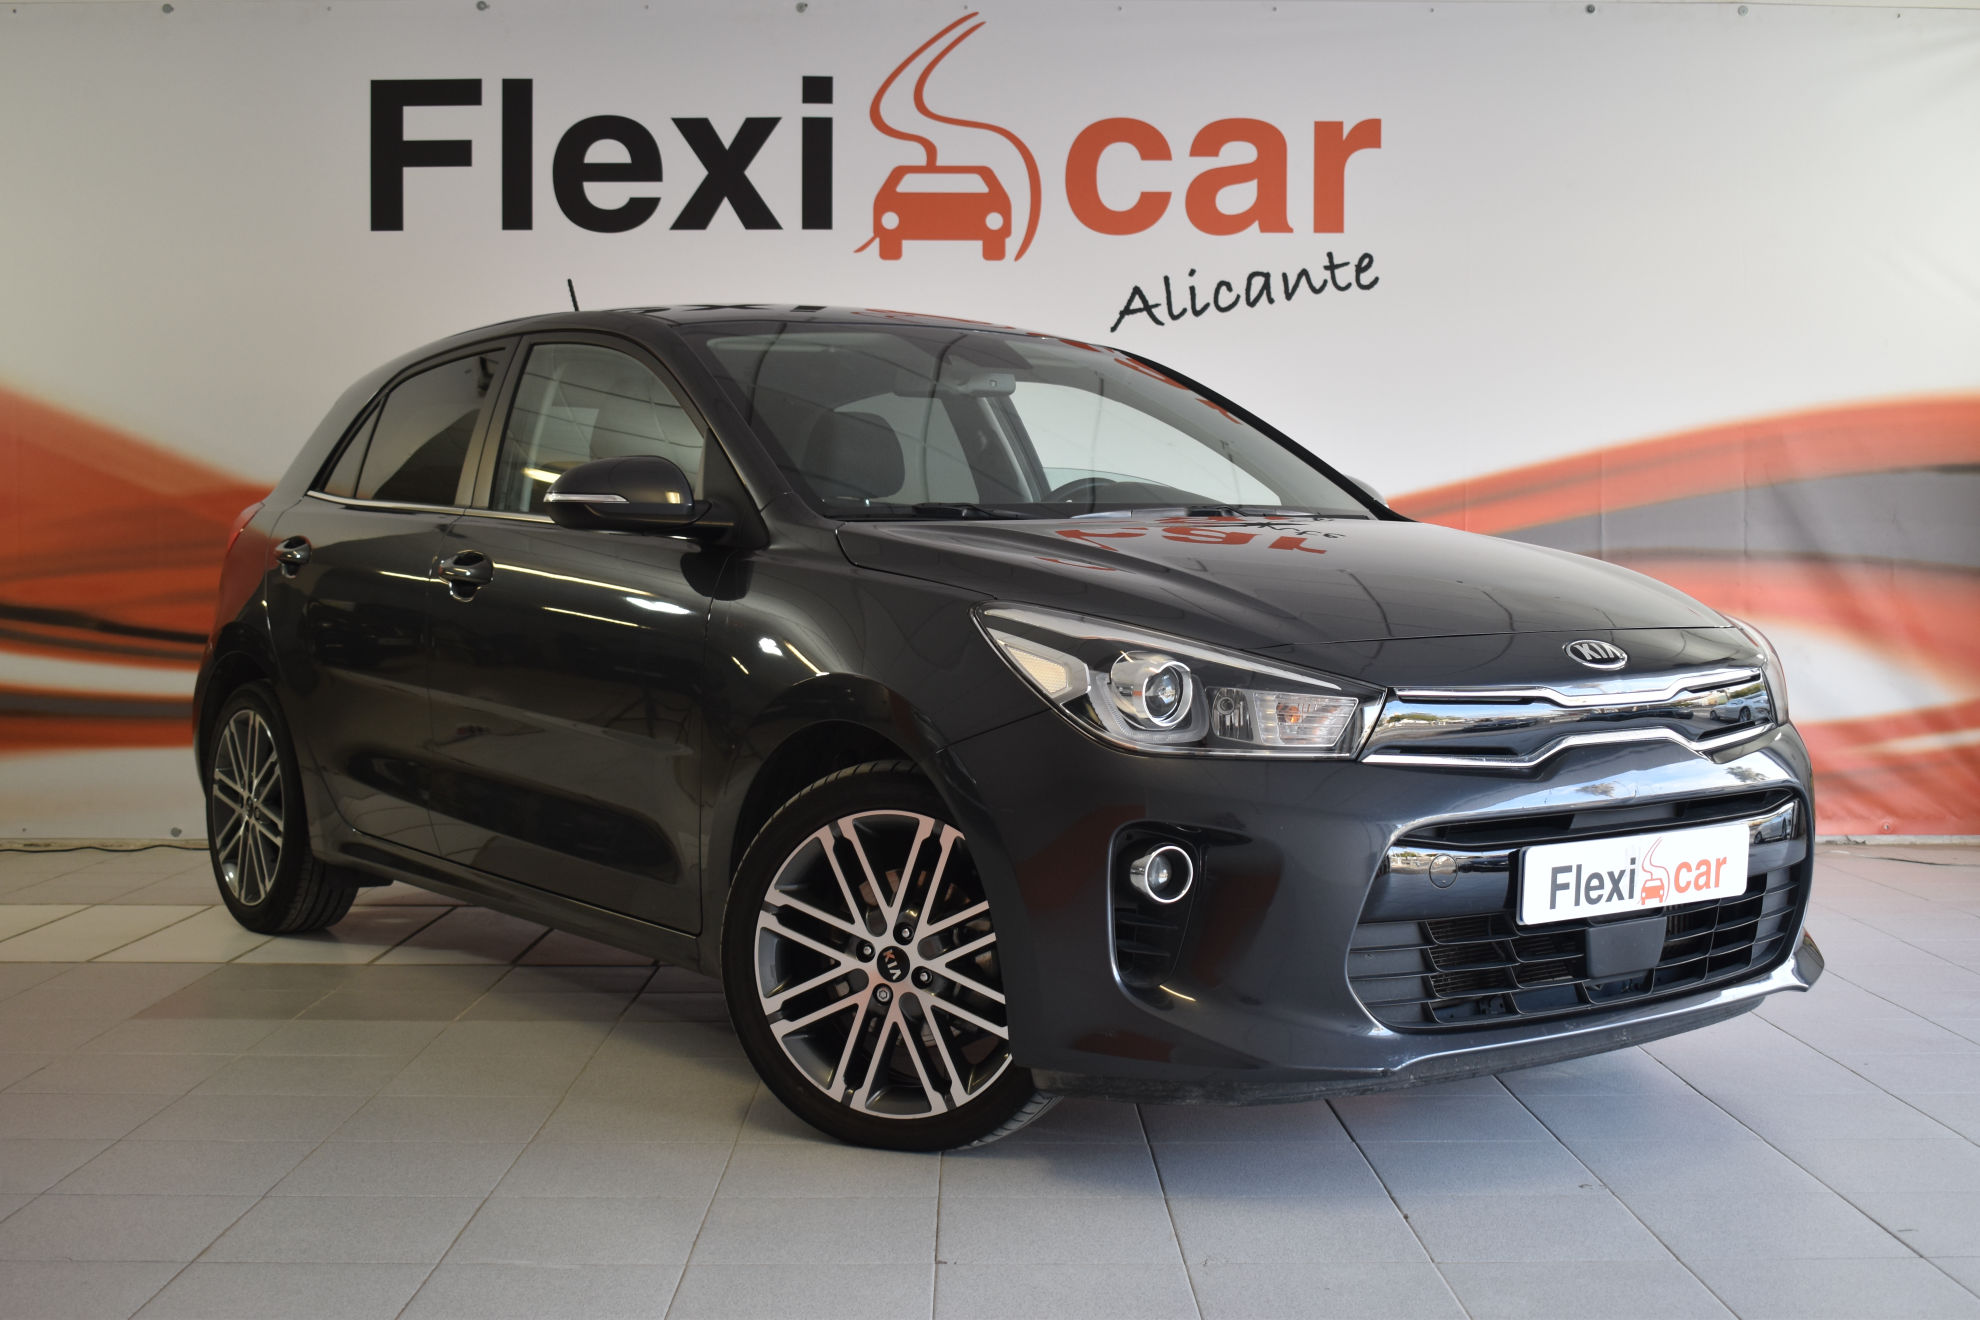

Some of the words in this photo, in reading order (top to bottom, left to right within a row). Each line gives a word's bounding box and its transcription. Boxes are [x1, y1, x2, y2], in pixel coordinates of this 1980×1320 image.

[1110, 250, 1381, 332] Alicante
[1573, 642, 1625, 660] KIA
[883, 948, 902, 981] KIA
